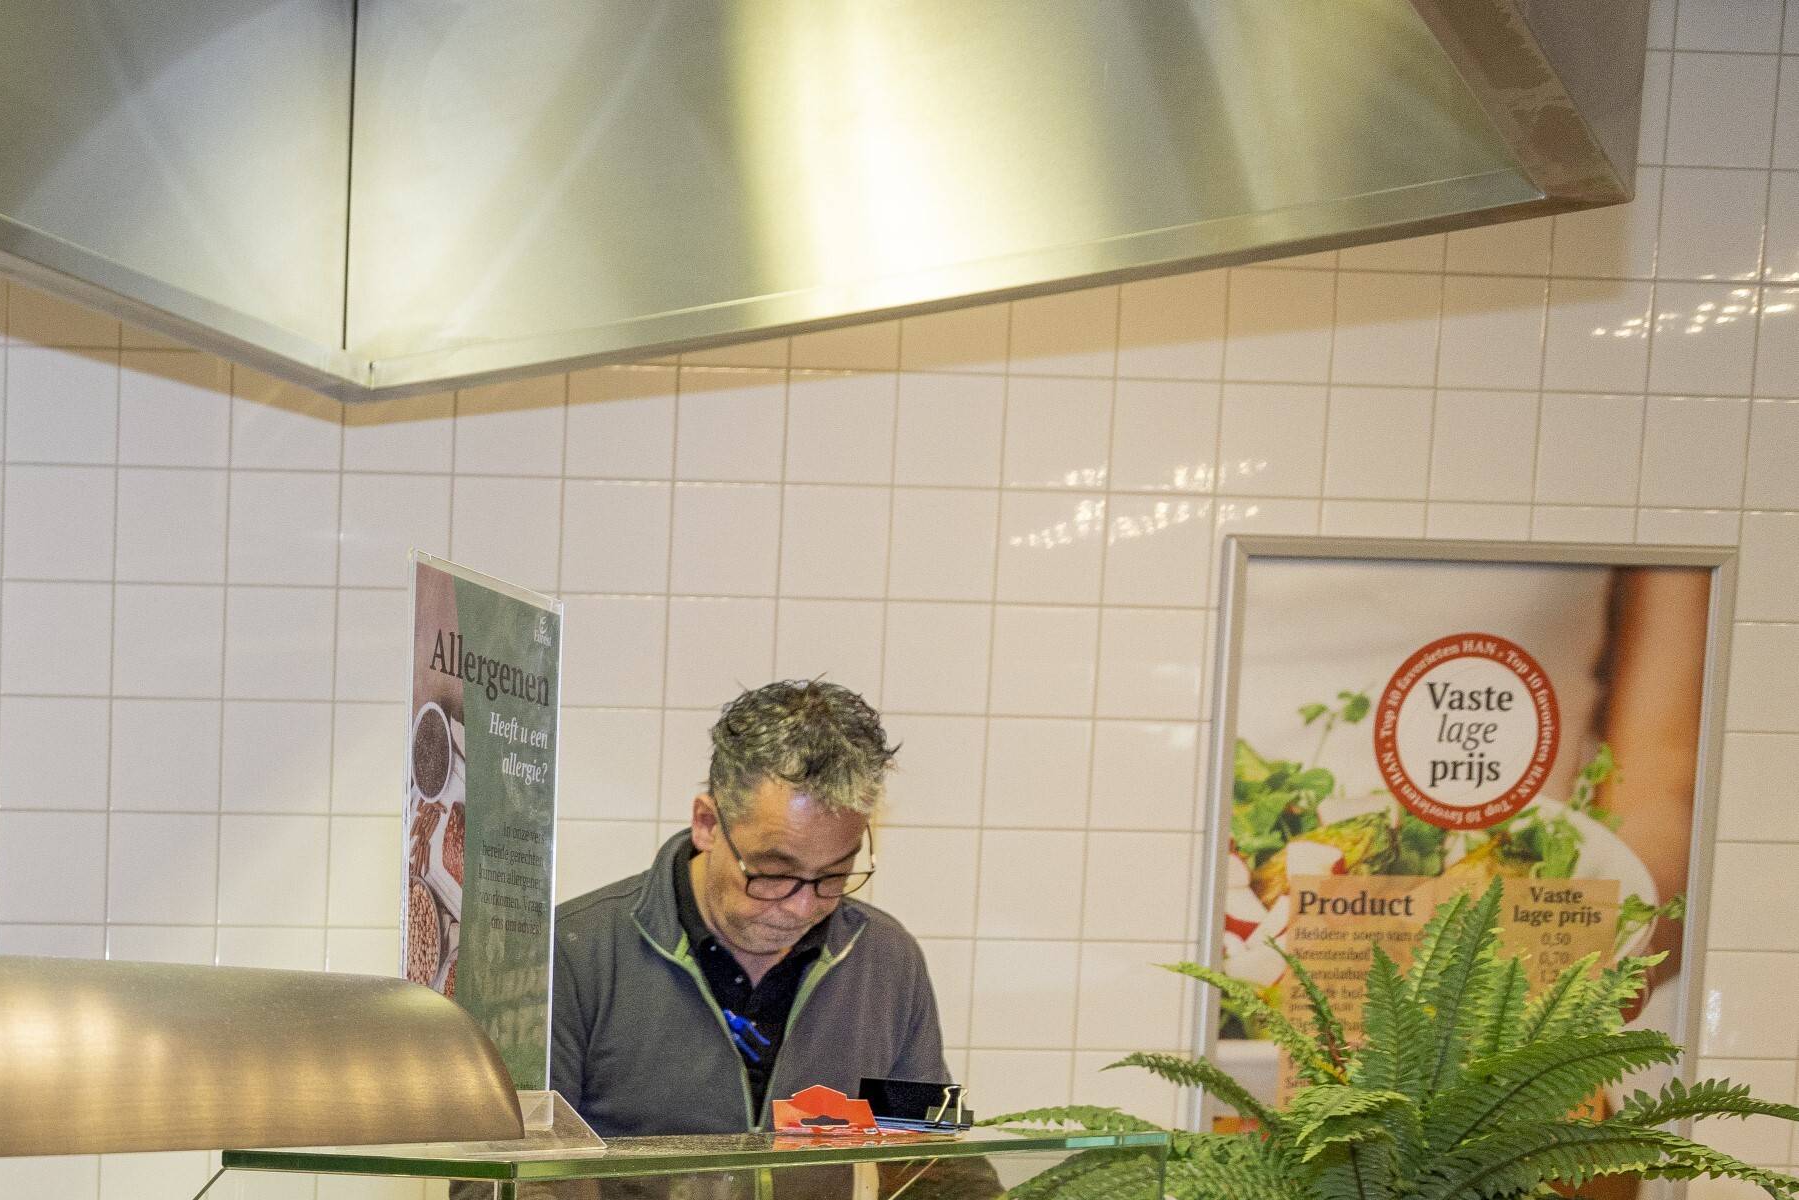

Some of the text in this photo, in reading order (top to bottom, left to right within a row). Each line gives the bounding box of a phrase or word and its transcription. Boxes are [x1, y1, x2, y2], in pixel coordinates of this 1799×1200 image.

[430, 628, 550, 707] Allergenen
[1427, 681, 1514, 711] Vaste
[489, 711, 548, 750] Heeft u een
[1437, 713, 1498, 751] lage
[502, 752, 548, 786] allergie?
[1428, 752, 1501, 788] prijs
[1298, 889, 1415, 917] Product
[1530, 886, 1584, 903] Vaste
[1513, 904, 1602, 927] lage prijs
